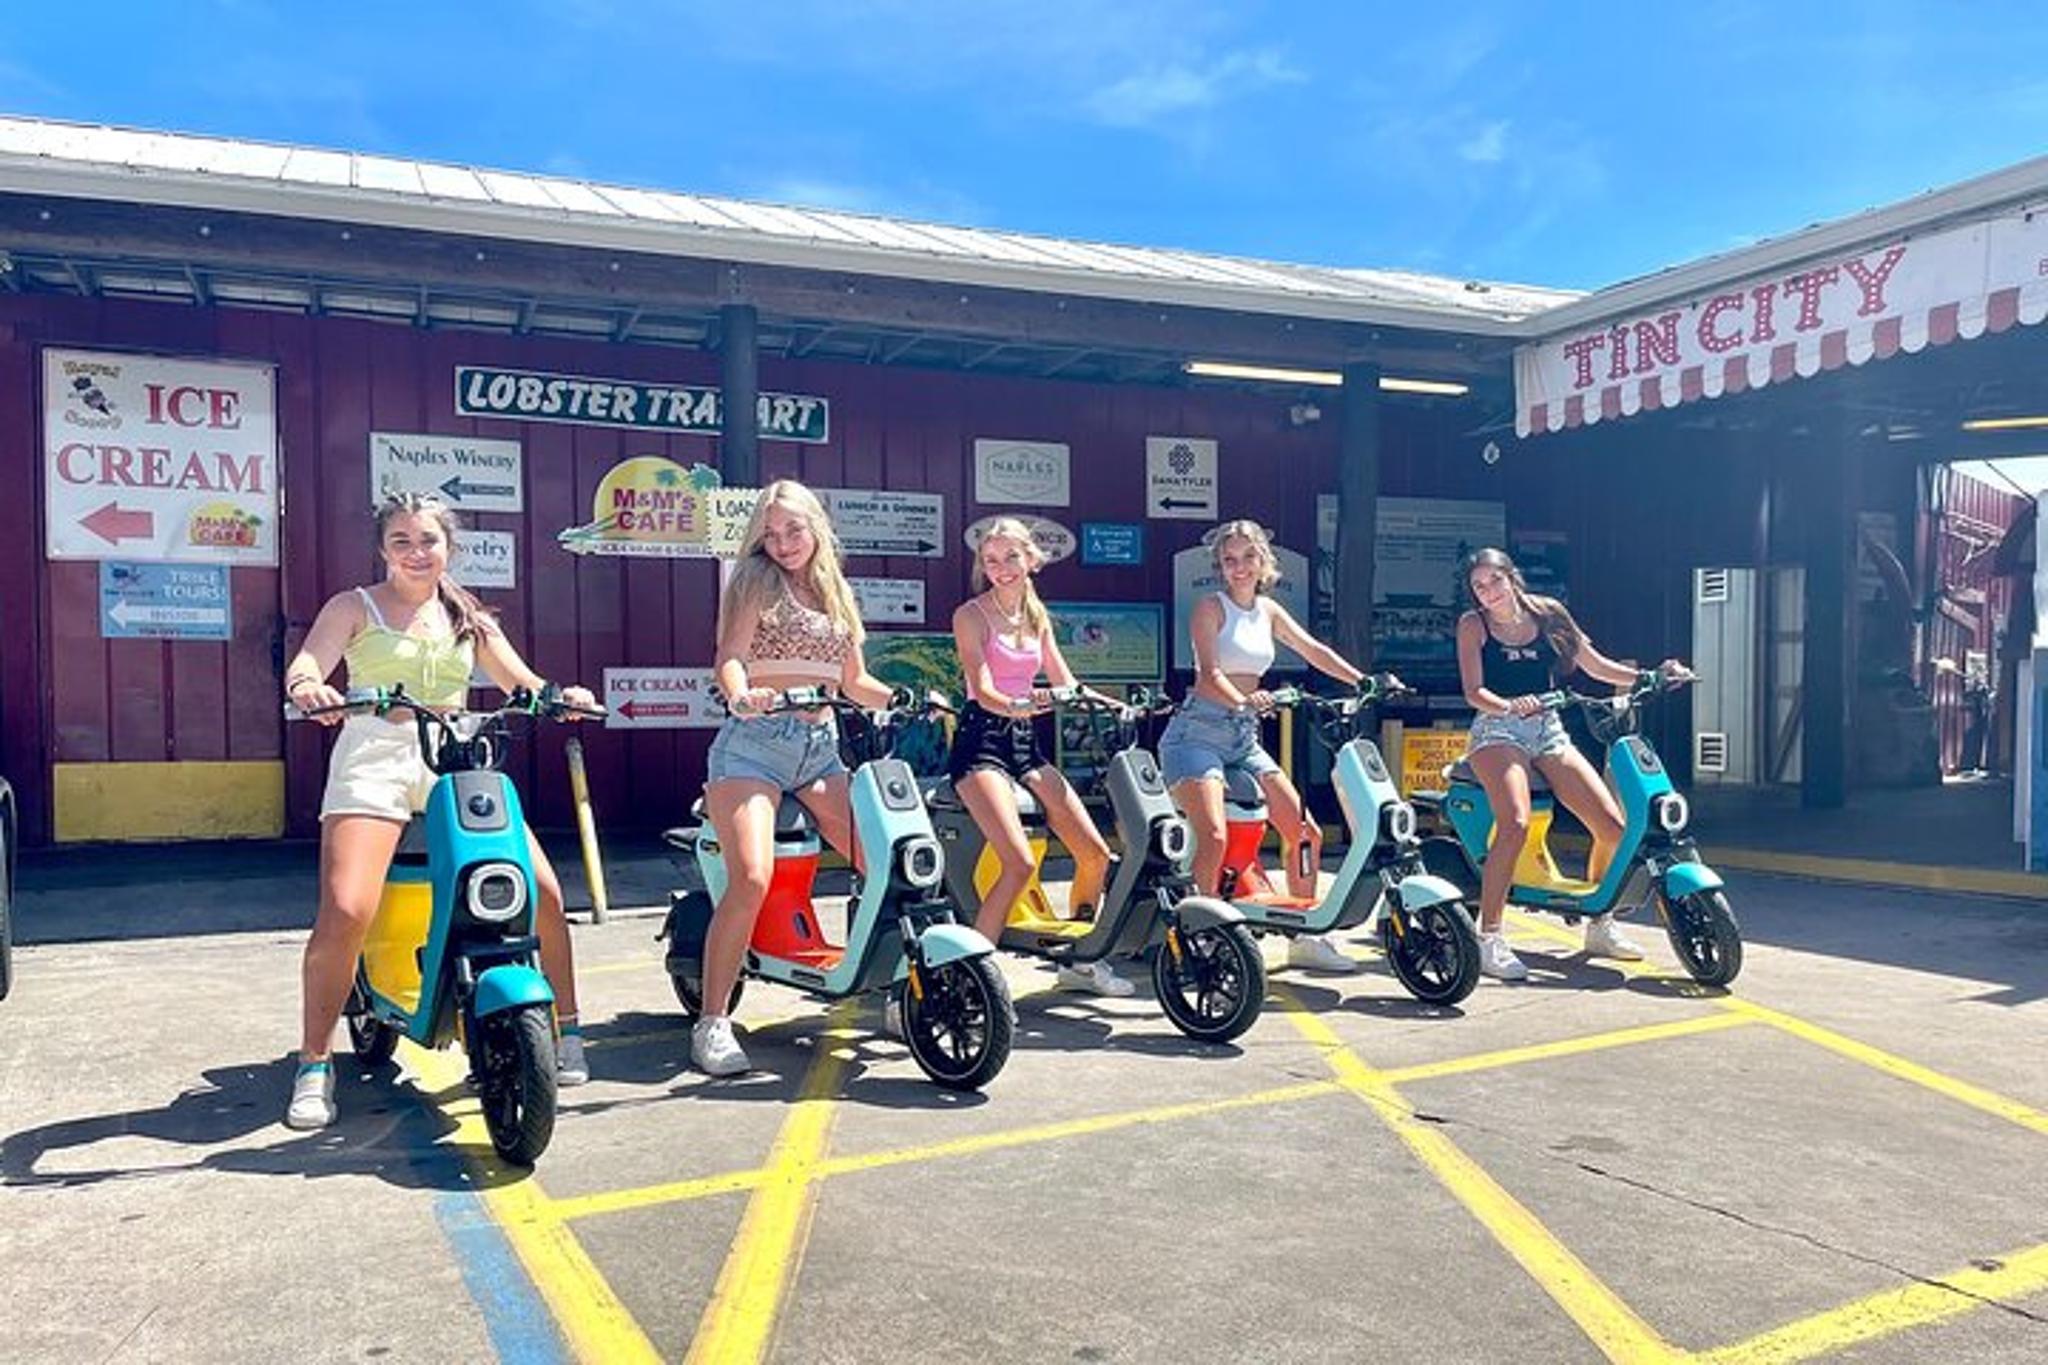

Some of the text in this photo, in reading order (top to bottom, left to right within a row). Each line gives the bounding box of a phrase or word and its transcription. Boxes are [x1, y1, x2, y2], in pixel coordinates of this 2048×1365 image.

[1563, 245, 1906, 390] TIN CITY
[144, 384, 241, 430] ICE
[467, 373, 638, 421] LOBSTER
[646, 389, 723, 425] TRA
[56, 443, 266, 494] CREAM
[991, 460, 1055, 474] NAPLES
[614, 489, 697, 510] M&M's
[838, 501, 879, 512] LUNCH
[893, 503, 937, 514] DINNER
[618, 512, 694, 532] CAFE
[611, 679, 697, 692] ICE CREAM
